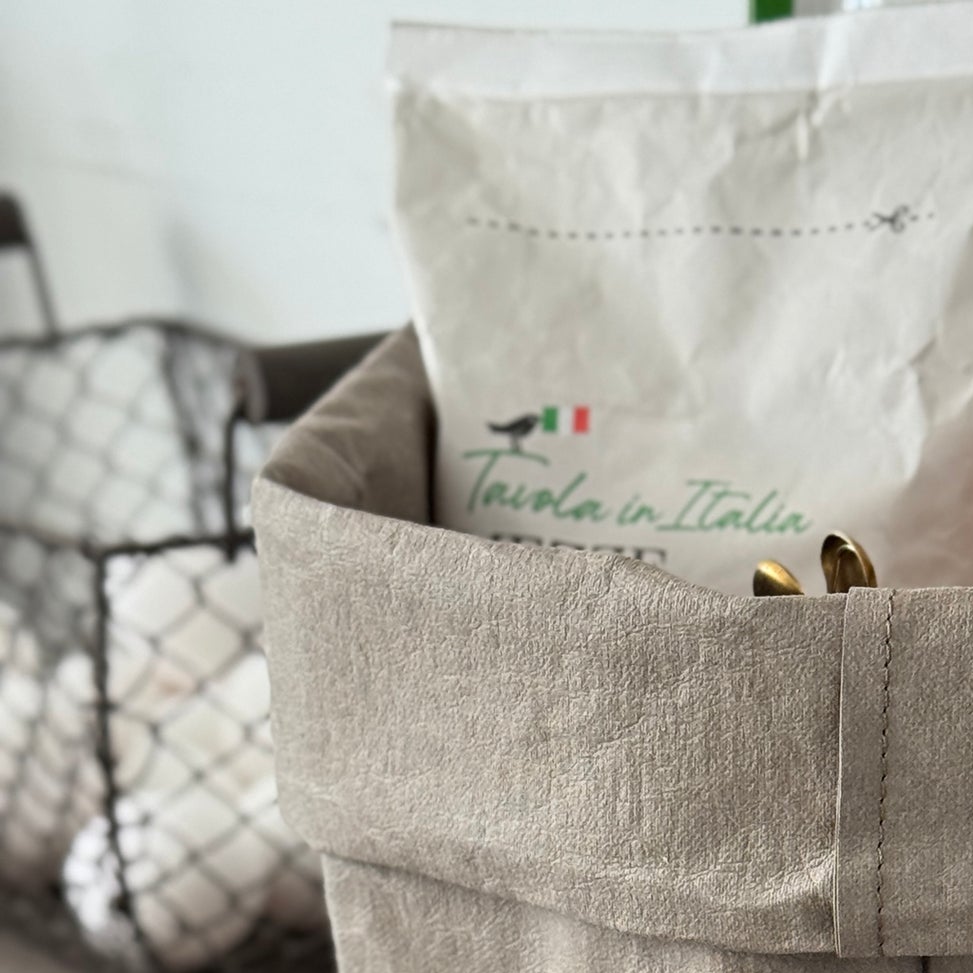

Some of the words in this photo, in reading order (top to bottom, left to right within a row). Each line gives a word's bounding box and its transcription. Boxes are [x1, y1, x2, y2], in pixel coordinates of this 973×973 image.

[462, 449, 604, 523] Tavola
[616, 495, 658, 525] in
[656, 479, 812, 535] Italia
